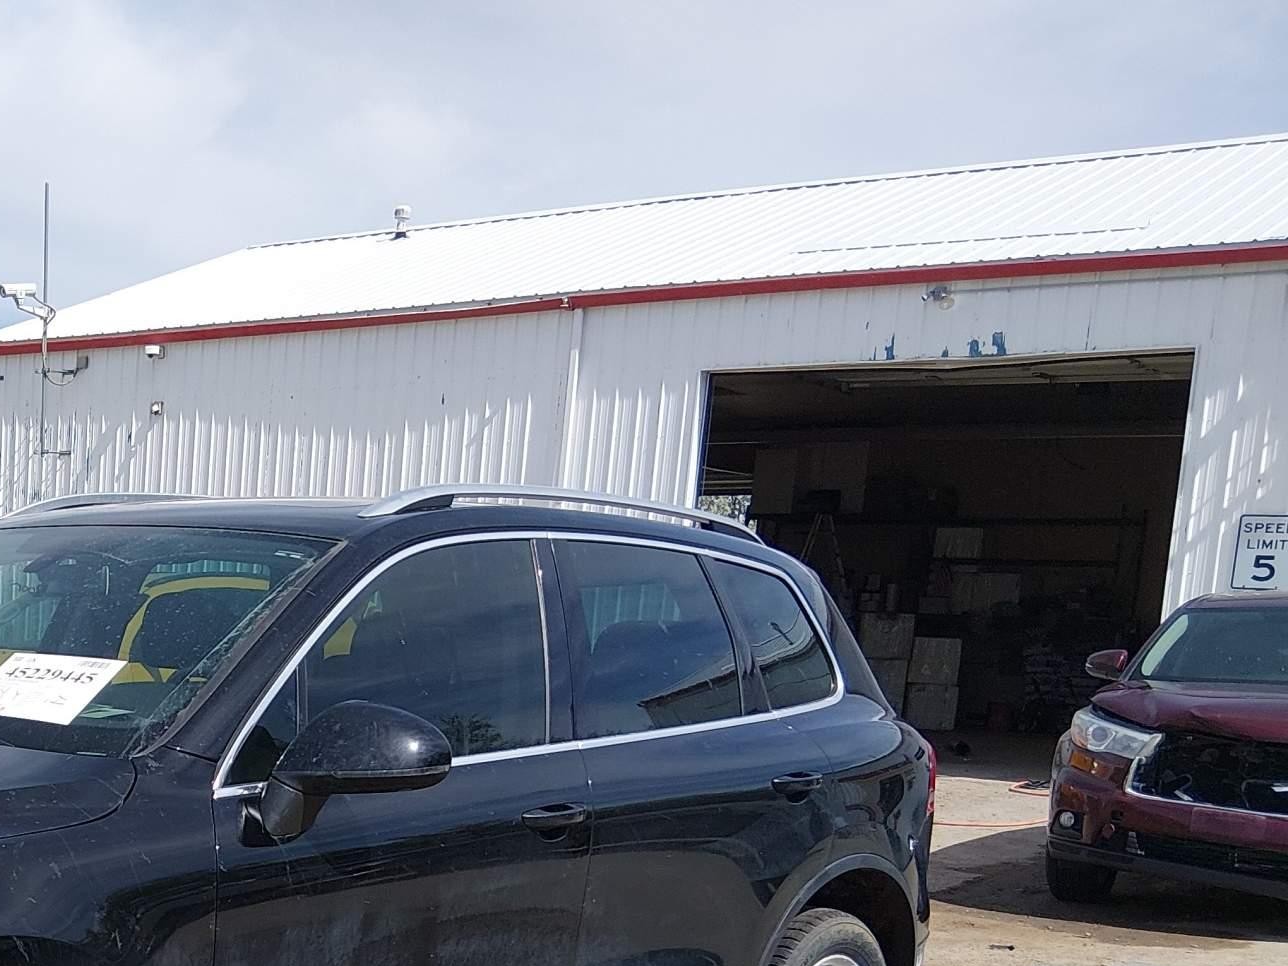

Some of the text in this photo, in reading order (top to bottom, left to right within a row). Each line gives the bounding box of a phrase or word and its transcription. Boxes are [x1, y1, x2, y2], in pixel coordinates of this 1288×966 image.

[1243, 522, 1288, 534] SPEE
[1246, 538, 1288, 550] LIMIT
[1250, 555, 1275, 582] 5
[4, 666, 99, 685] 45229445
